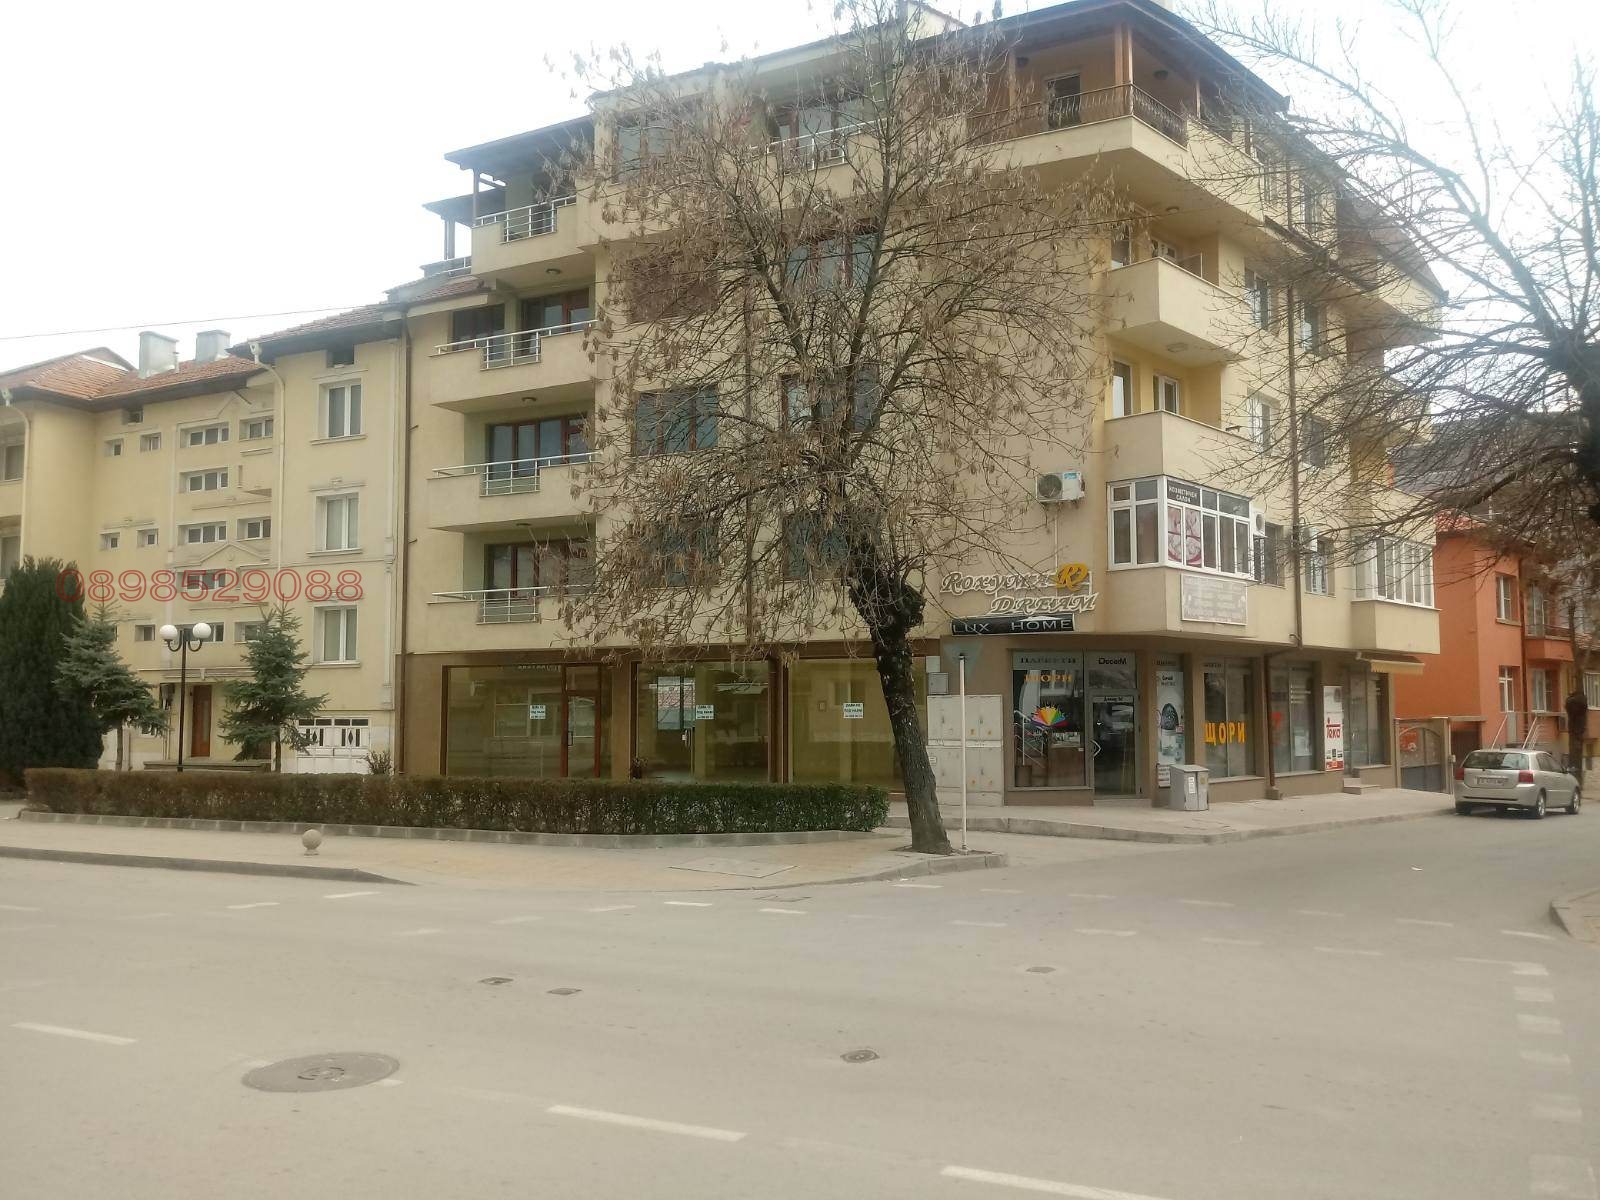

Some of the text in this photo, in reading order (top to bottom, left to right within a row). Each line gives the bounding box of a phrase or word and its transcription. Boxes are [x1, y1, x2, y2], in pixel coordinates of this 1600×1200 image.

[986, 592, 1099, 616] DREAM
[953, 619, 1073, 634] LUX HOME
[1205, 721, 1246, 746] ЩОРИ
